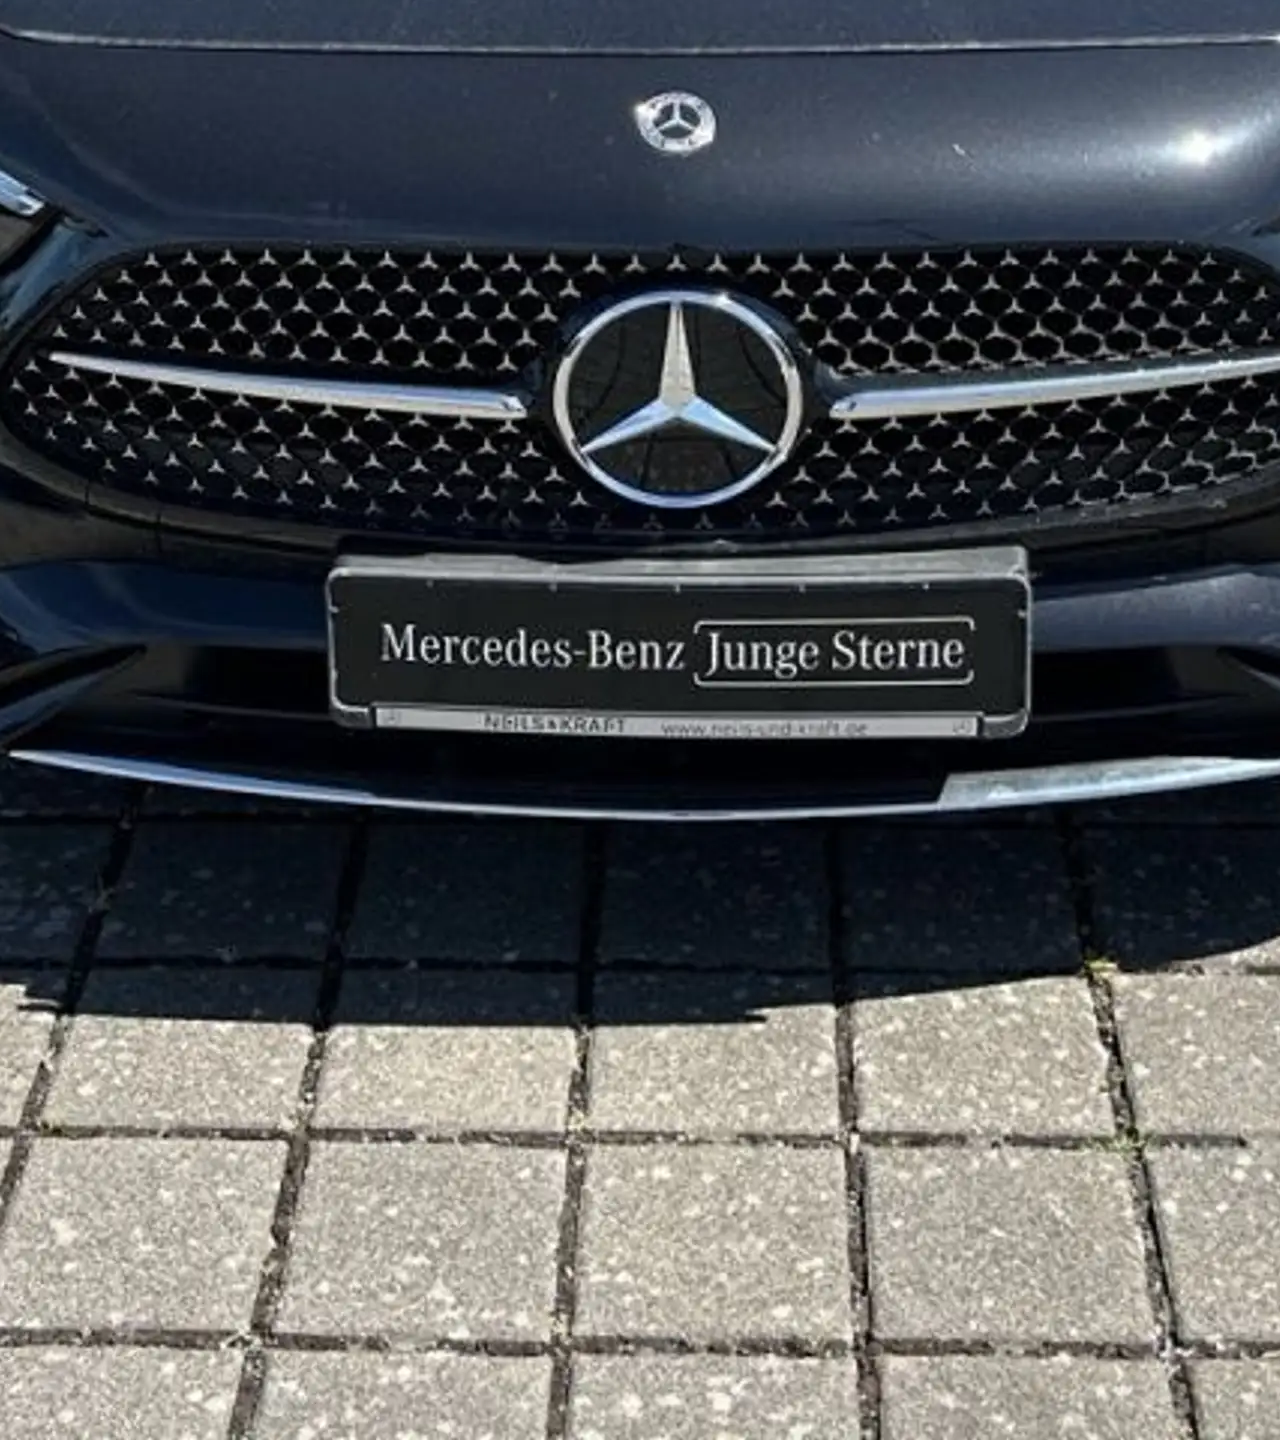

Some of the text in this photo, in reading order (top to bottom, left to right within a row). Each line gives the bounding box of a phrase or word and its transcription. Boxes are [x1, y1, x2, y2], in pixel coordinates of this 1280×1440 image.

[380, 622, 965, 680] Mercedes-Benz Junge Sterne
